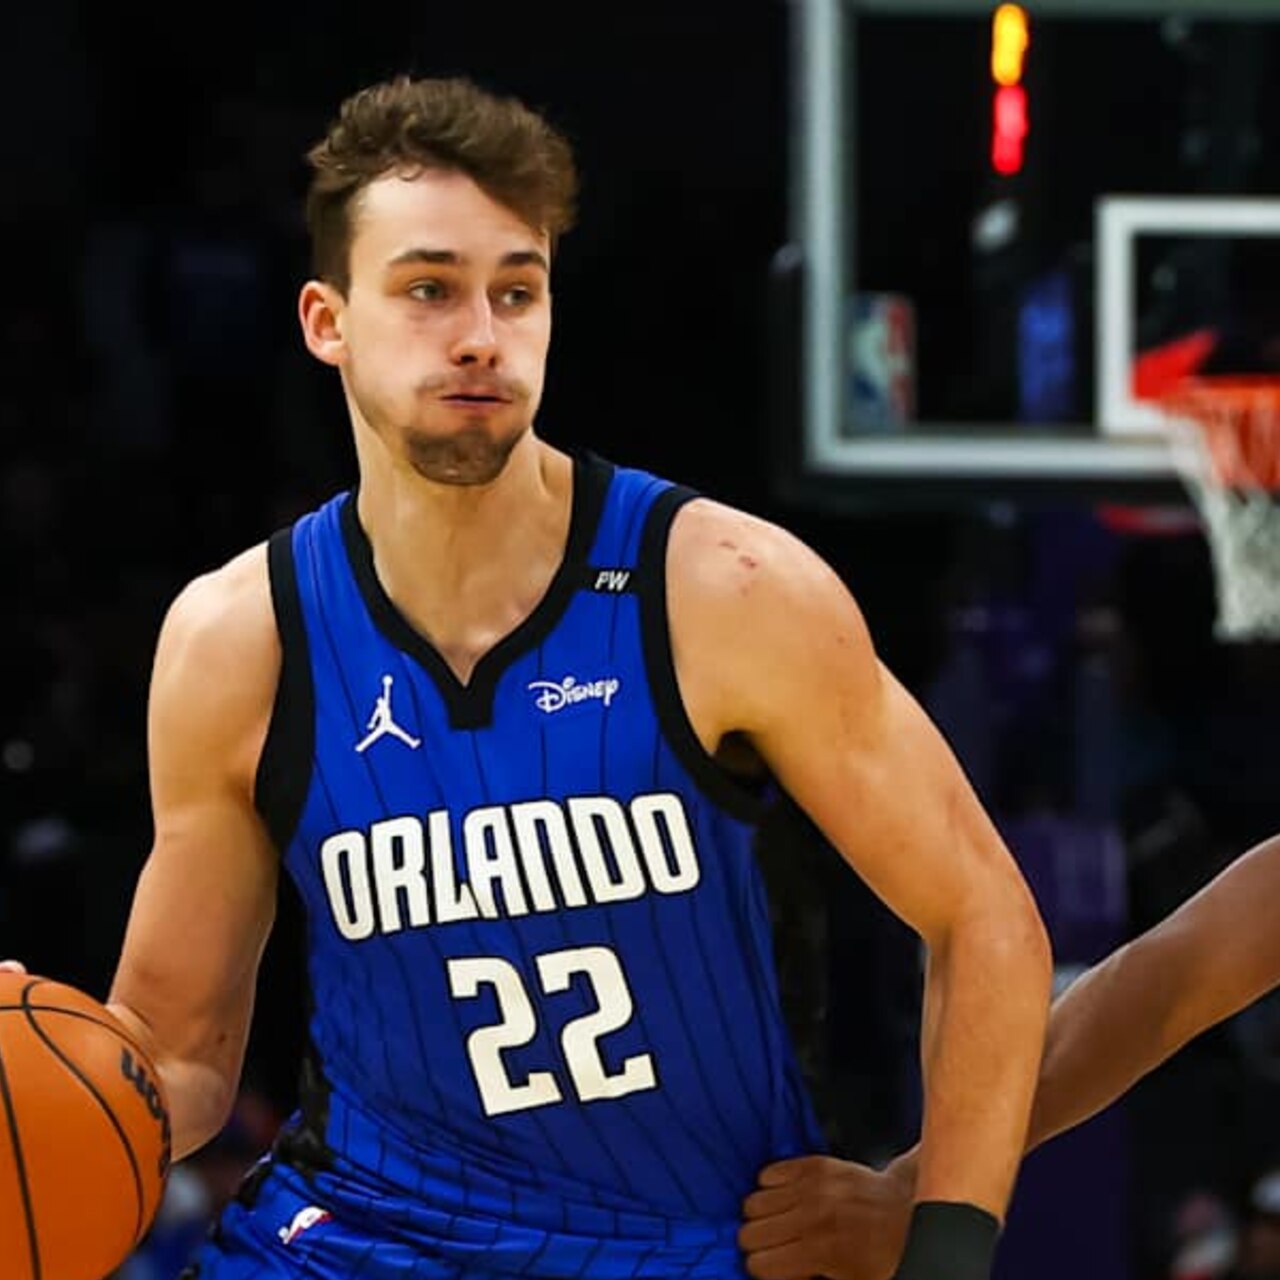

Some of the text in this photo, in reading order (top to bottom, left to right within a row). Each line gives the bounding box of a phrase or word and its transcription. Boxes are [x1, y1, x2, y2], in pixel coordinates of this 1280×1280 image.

[594, 570, 630, 591] PW
[527, 676, 619, 713] Disney
[321, 794, 700, 941] ORLANDO
[447, 945, 657, 1117] 22
